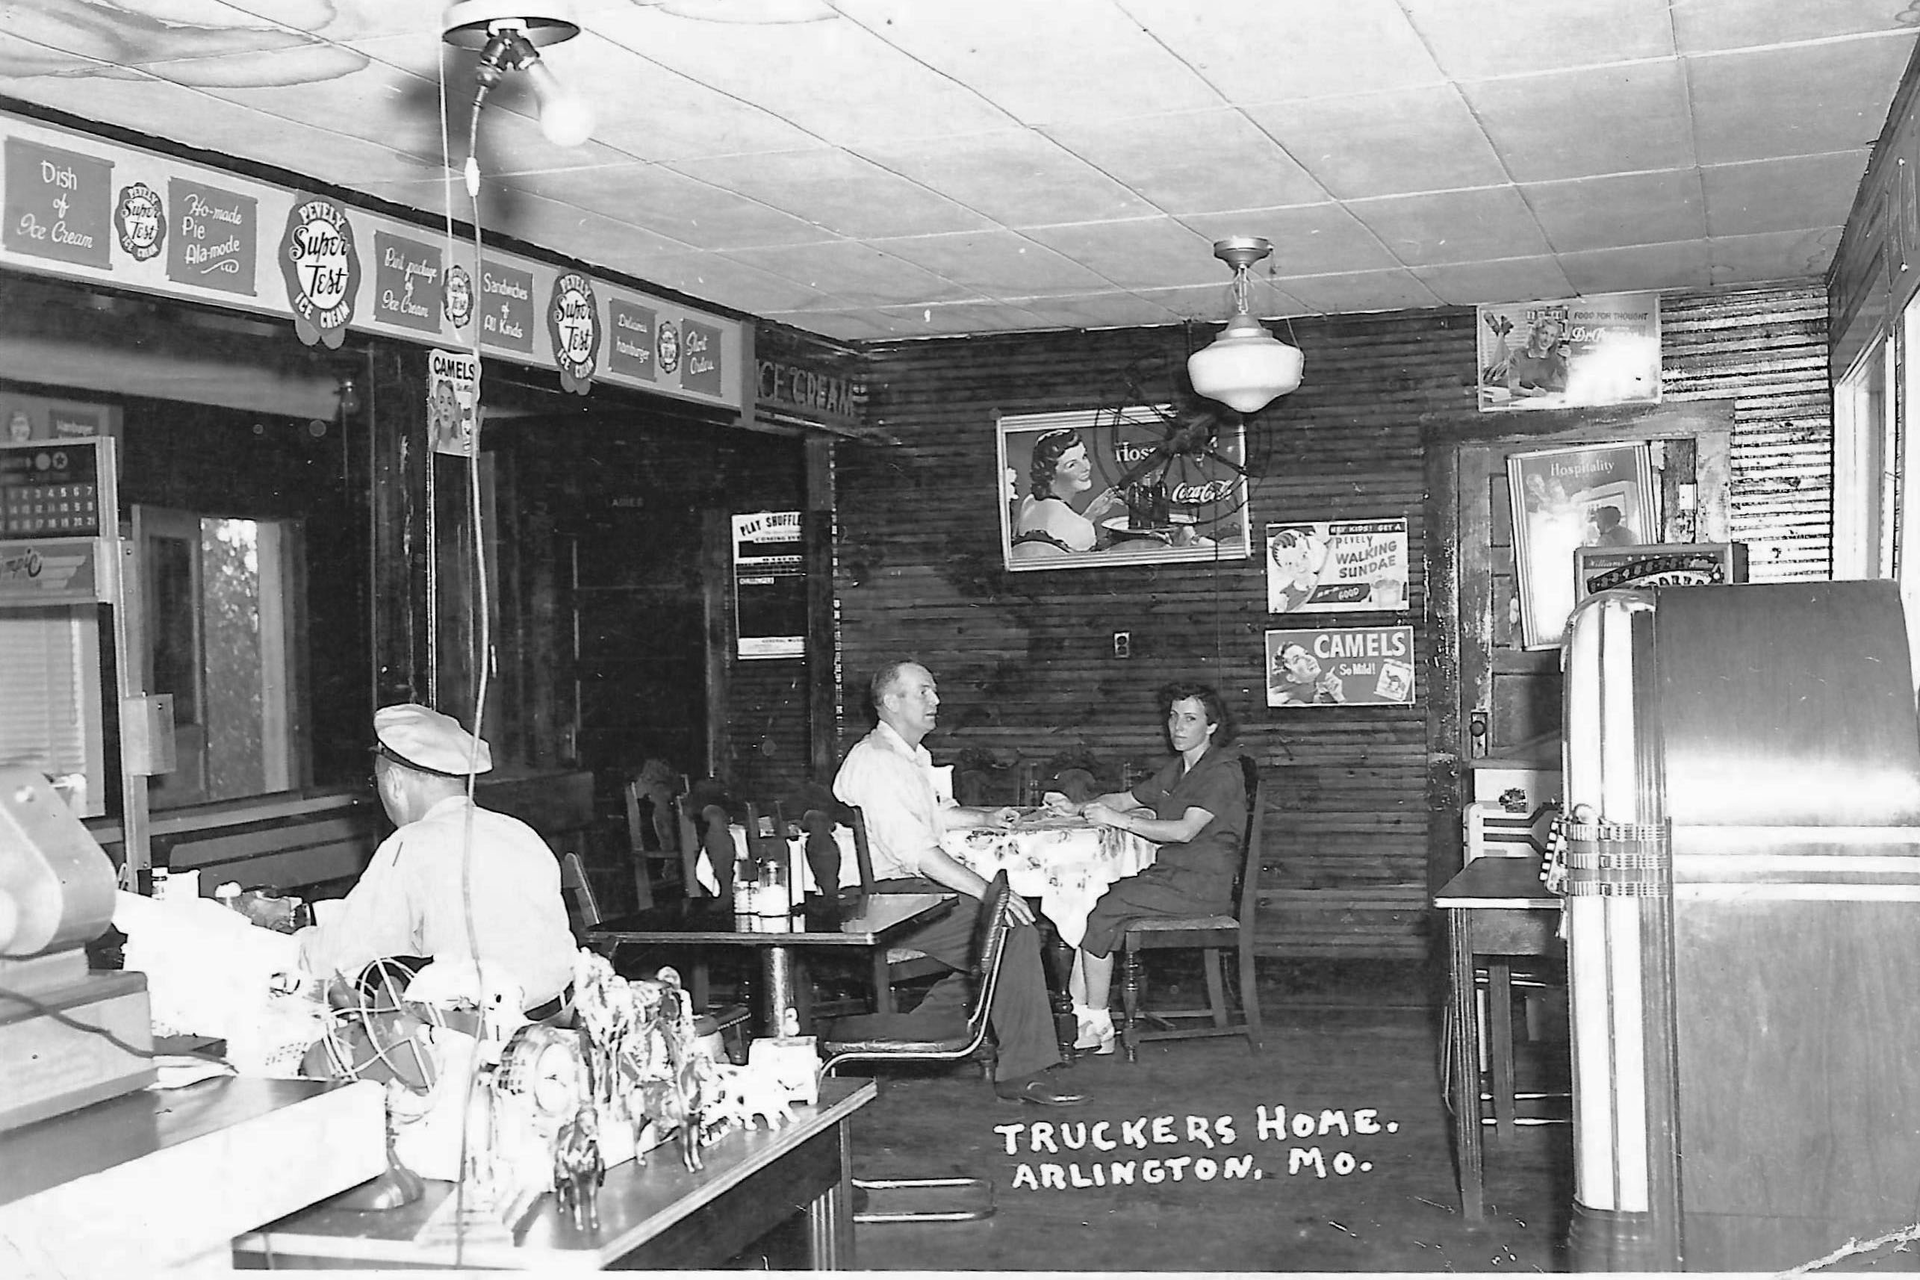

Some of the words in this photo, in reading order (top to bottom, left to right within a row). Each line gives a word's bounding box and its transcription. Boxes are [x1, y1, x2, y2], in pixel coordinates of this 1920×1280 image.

[40, 160, 78, 190] Dish
[52, 192, 70, 219] of
[120, 198, 162, 221] Super
[184, 194, 243, 225] Ho-made
[298, 201, 346, 230] PEVELY
[17, 213, 47, 240] Ice
[51, 220, 93, 249] Cream
[130, 220, 160, 240] Test
[181, 216, 206, 240] Pie
[121, 235, 135, 251] ICE
[289, 225, 352, 263] Super
[304, 264, 349, 298] Test
[483, 272, 528, 300] Sandwiches
[560, 274, 592, 299] PEVELY
[295, 291, 314, 320] ICE
[320, 300, 350, 329] CREAM
[381, 289, 400, 311] Ice
[400, 295, 429, 318] Cream
[501, 301, 510, 319] of
[554, 294, 595, 323] Super
[1573, 311, 1595, 320] FOOD
[1596, 312, 1611, 320] FOR
[1613, 312, 1649, 321] THOUGHT
[484, 314, 497, 332] All
[499, 318, 523, 339] Kinds
[564, 325, 593, 353] Test
[433, 356, 476, 382] CAMELS
[557, 348, 572, 371] ICE
[755, 358, 785, 403] ICE
[790, 367, 855, 418] CREAM
[1550, 459, 1615, 479] Hospitality
[47, 488, 54, 497] 4
[60, 487, 67, 497] 5
[73, 486, 79, 496] 6
[87, 486, 93, 495] 7
[739, 520, 761, 537] PLAY
[1377, 524, 1393, 532] GET
[1335, 535, 1373, 550] PEVELY
[1336, 540, 1398, 565] WALKING
[1339, 555, 1397, 579] SUNDAE
[1314, 631, 1406, 659] CAMELS
[1339, 663, 1352, 676] So
[1352, 662, 1376, 675] Mild!
